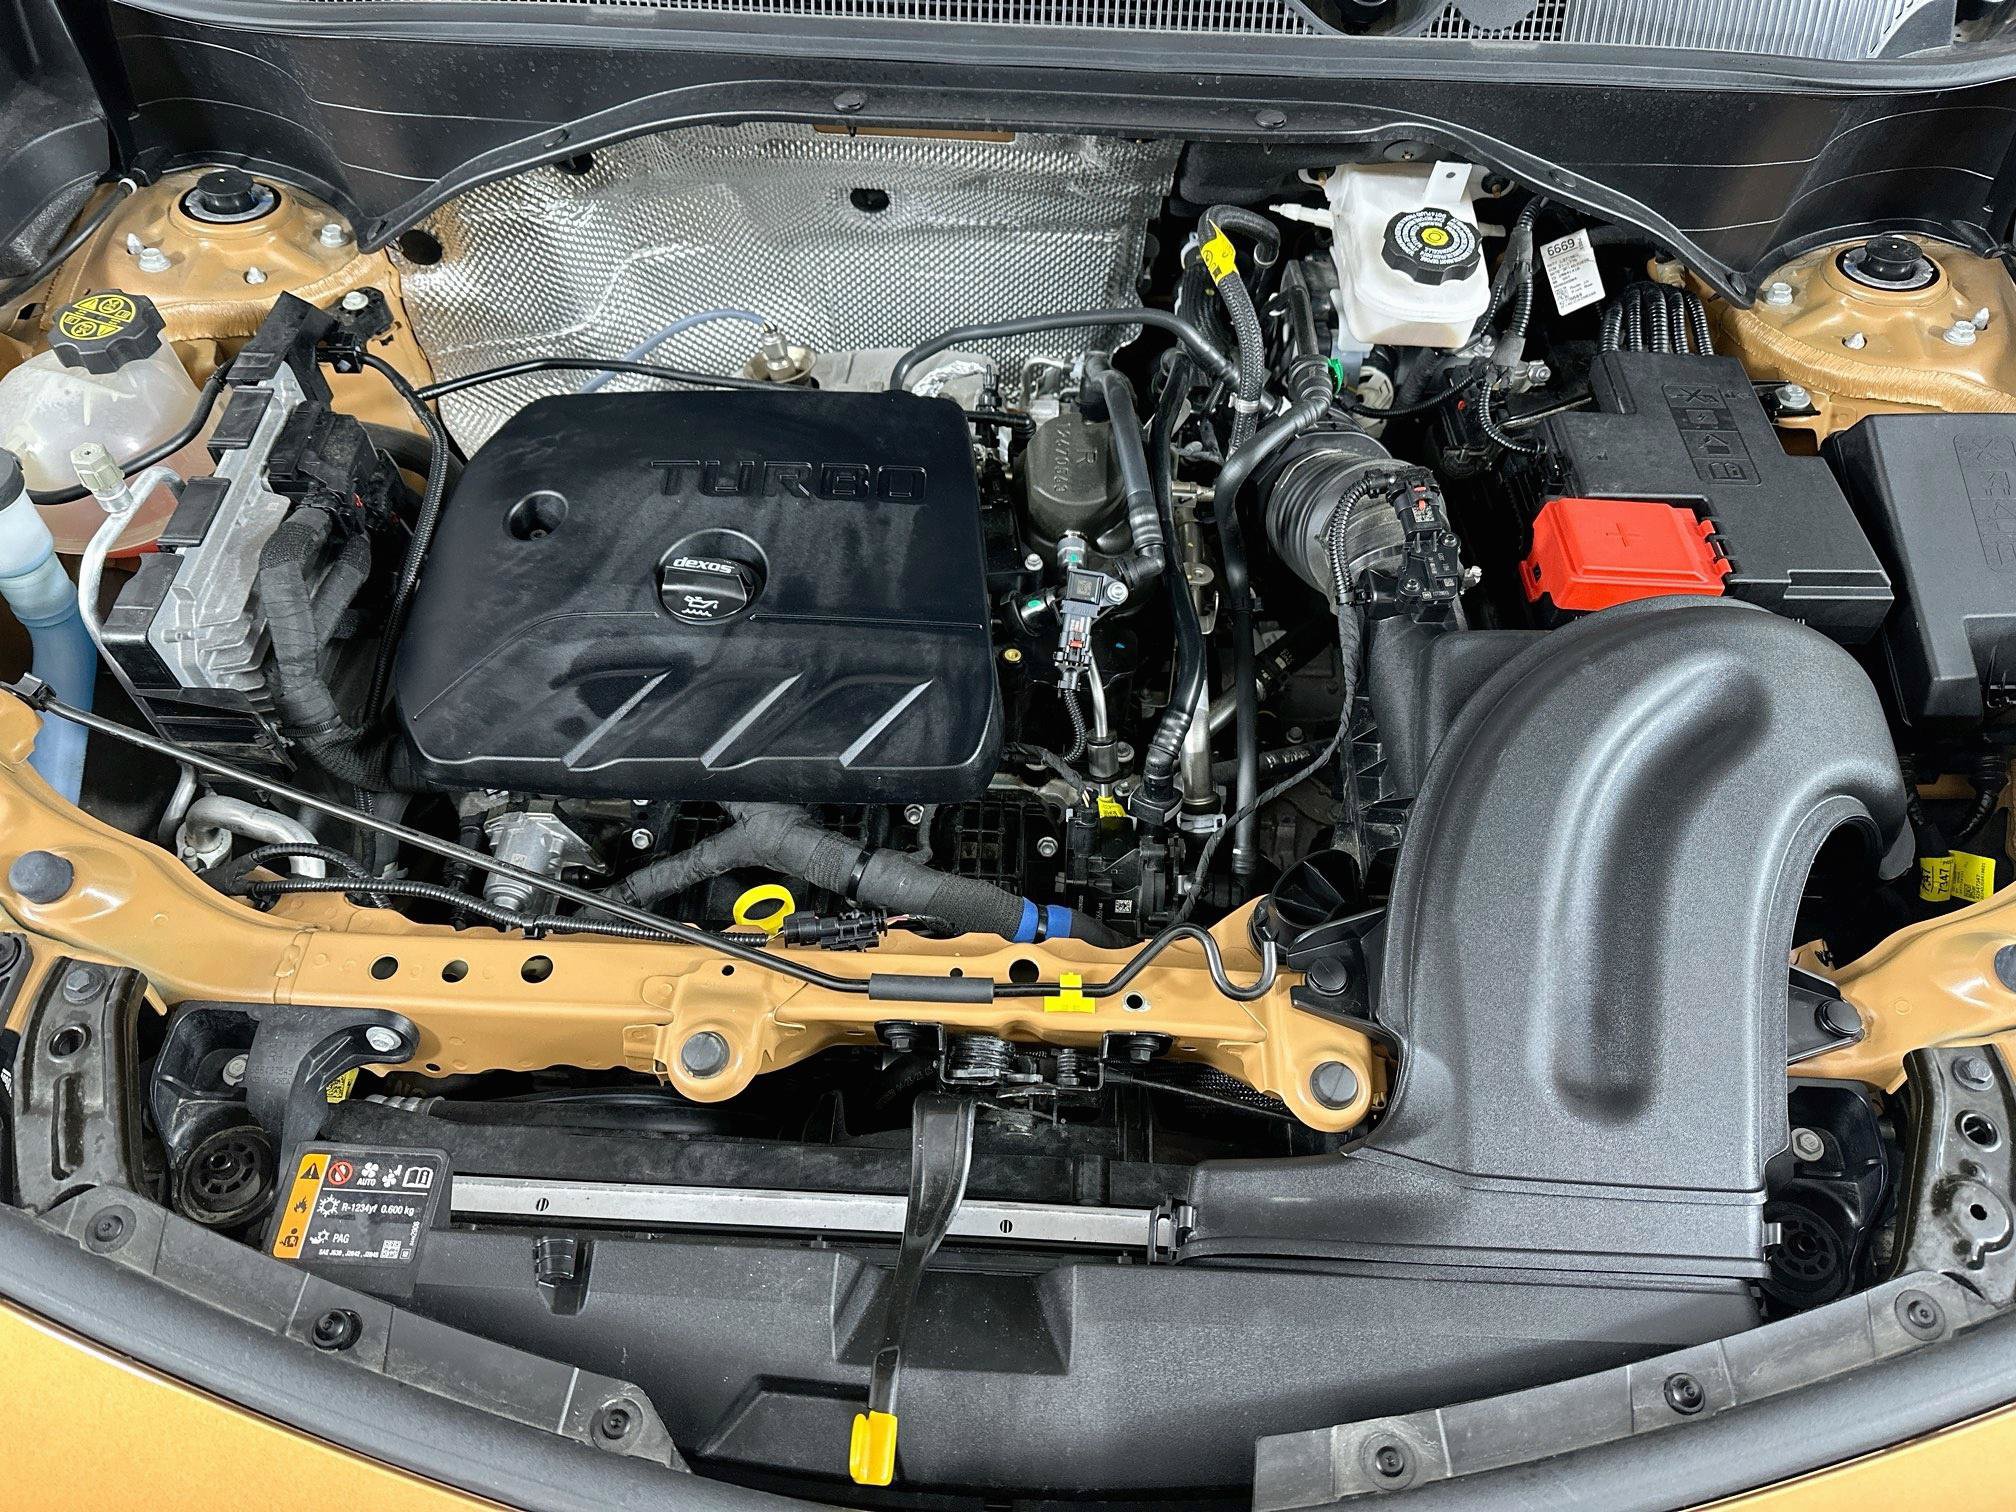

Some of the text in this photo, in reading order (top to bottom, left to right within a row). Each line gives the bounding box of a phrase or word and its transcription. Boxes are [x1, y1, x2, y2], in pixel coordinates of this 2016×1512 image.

[1547, 238, 1575, 256] 6669
[651, 460, 927, 503] TURBO
[672, 556, 736, 574] dexos
[1938, 868, 1949, 894] 7347
[357, 1177, 377, 1187] AUTO
[341, 1202, 415, 1217] R-1234yf 0.600 kg
[332, 1233, 351, 1244] PAG
